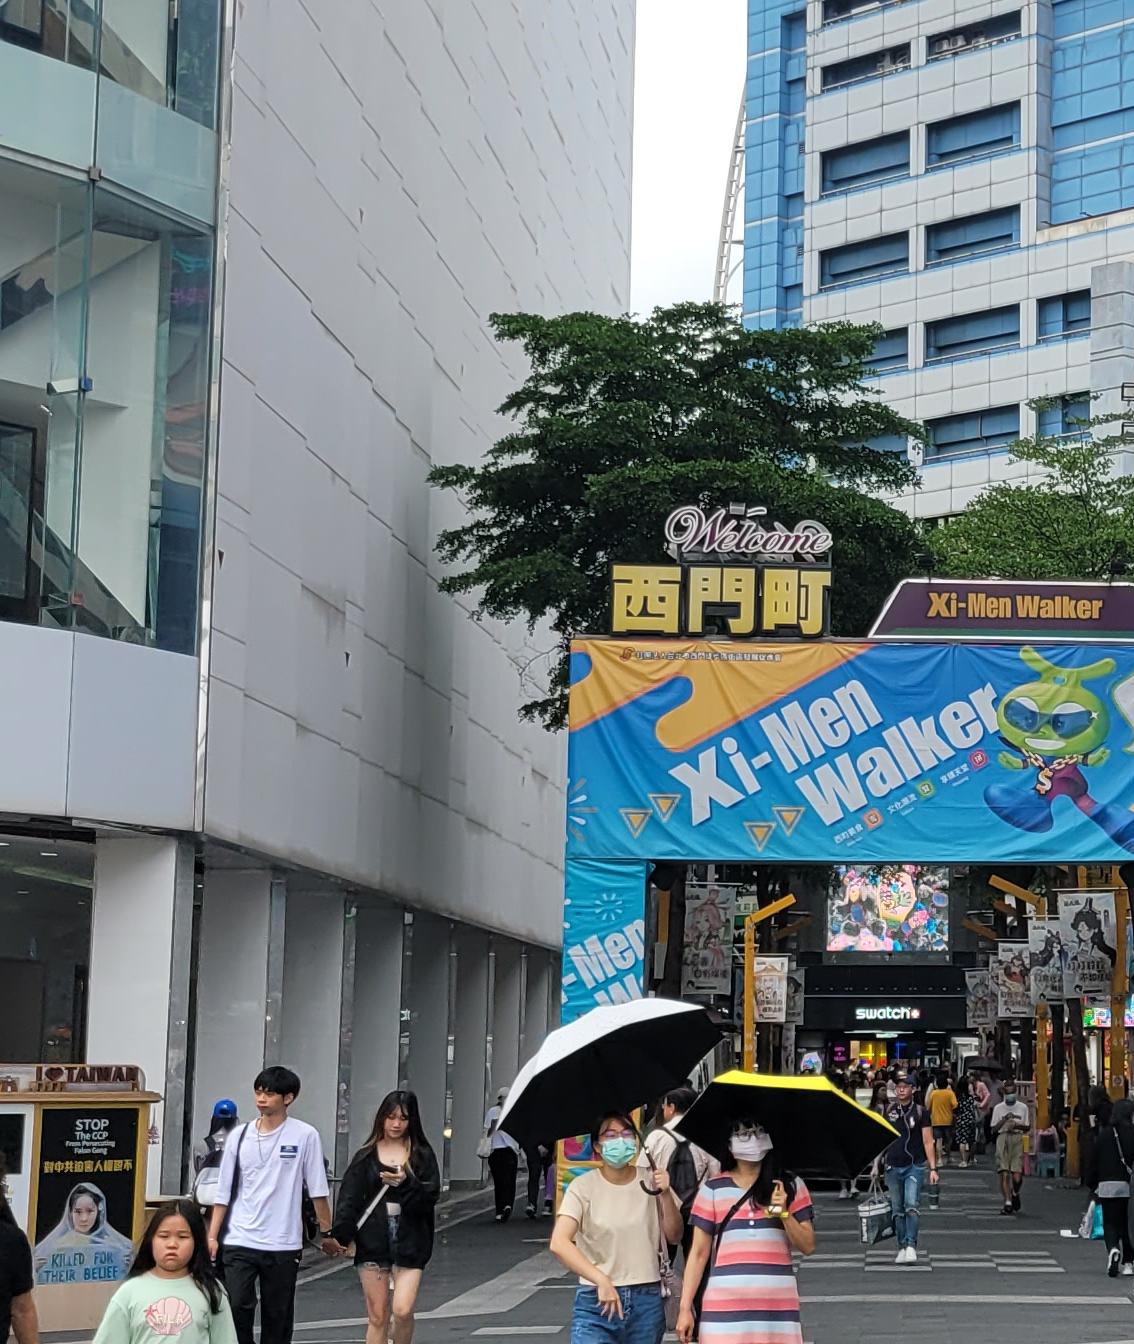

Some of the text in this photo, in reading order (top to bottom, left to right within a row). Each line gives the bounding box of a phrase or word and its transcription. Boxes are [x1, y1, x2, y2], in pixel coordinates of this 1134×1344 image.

[664, 505, 834, 555] Welcome
[611, 564, 833, 636] 西門町
[927, 591, 1103, 622] Xi-Men Walker
[668, 678, 883, 827] Xi-Men
[795, 680, 1005, 828] Walker
[855, 1006, 912, 1020] swatch
[66, 1066, 139, 1084] TAIWAN
[75, 1118, 110, 1131] STOP
[75, 1131, 109, 1141] The CCP
[50, 1251, 86, 1267] KILLED
[43, 1265, 119, 1283] THEIR BELIEF
